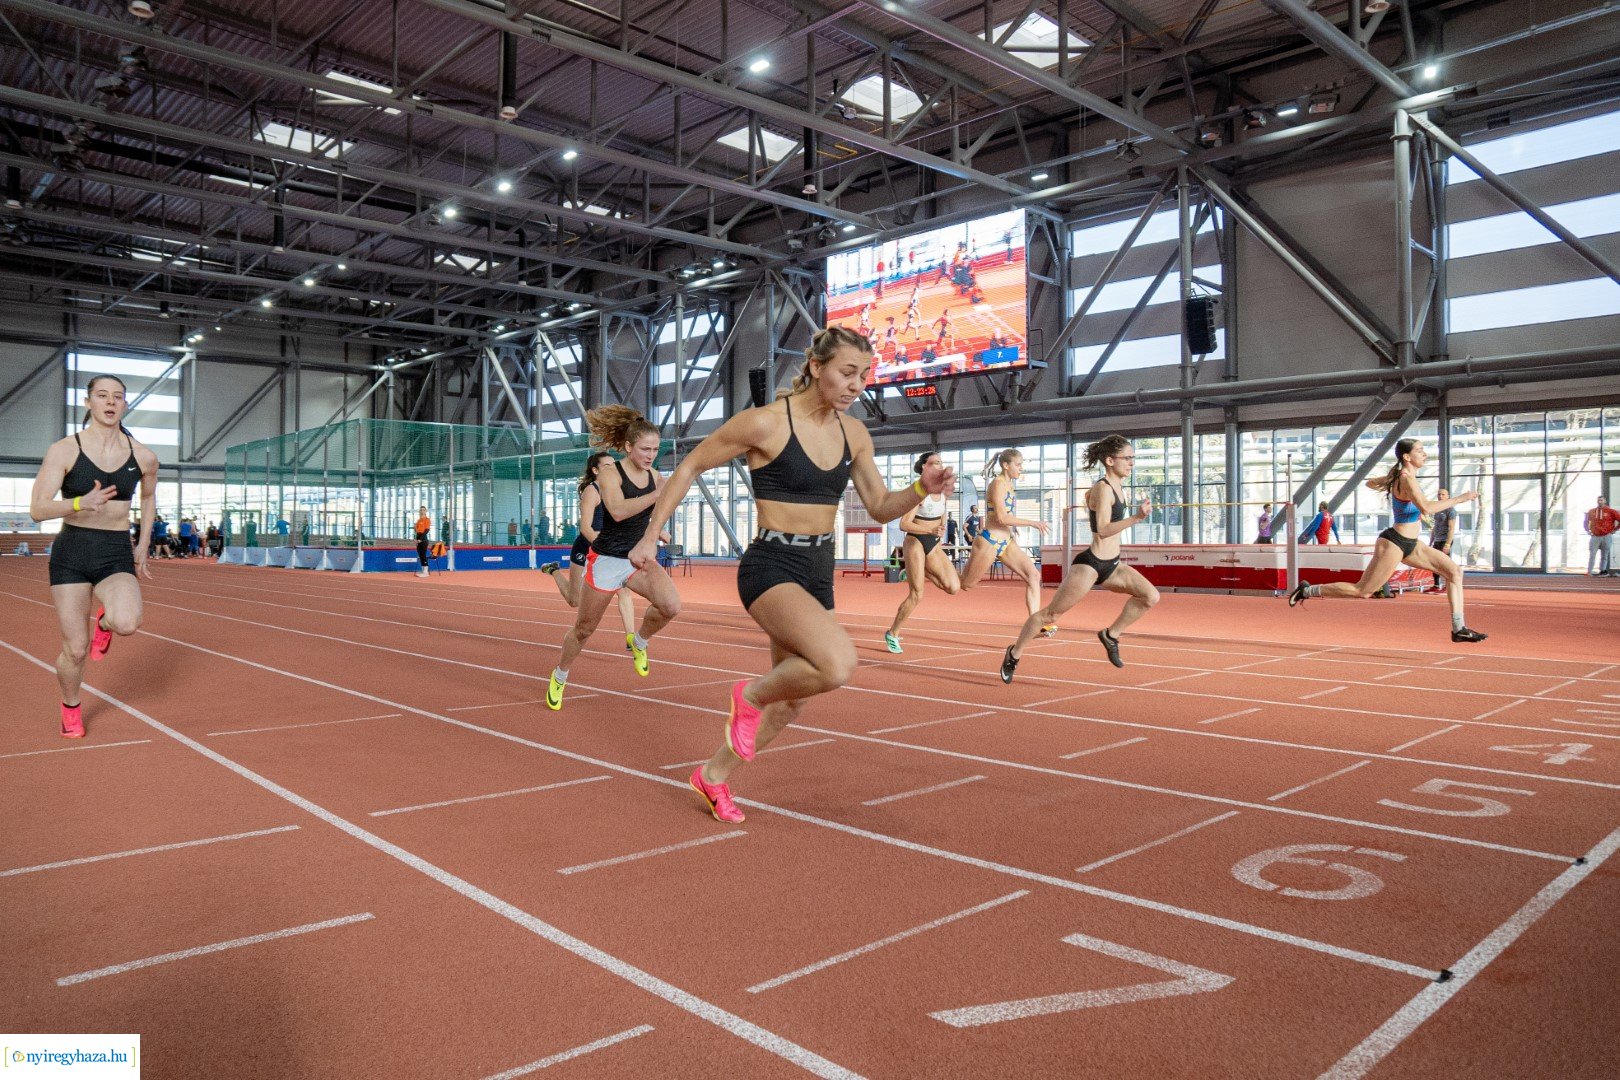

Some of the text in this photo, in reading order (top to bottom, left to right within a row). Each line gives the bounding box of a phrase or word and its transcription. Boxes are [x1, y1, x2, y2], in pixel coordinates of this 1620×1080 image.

[1488, 742, 1596, 765] 4
[1377, 778, 1536, 818] 5
[1231, 843, 1407, 900] 6
[931, 933, 1236, 1028] 7
